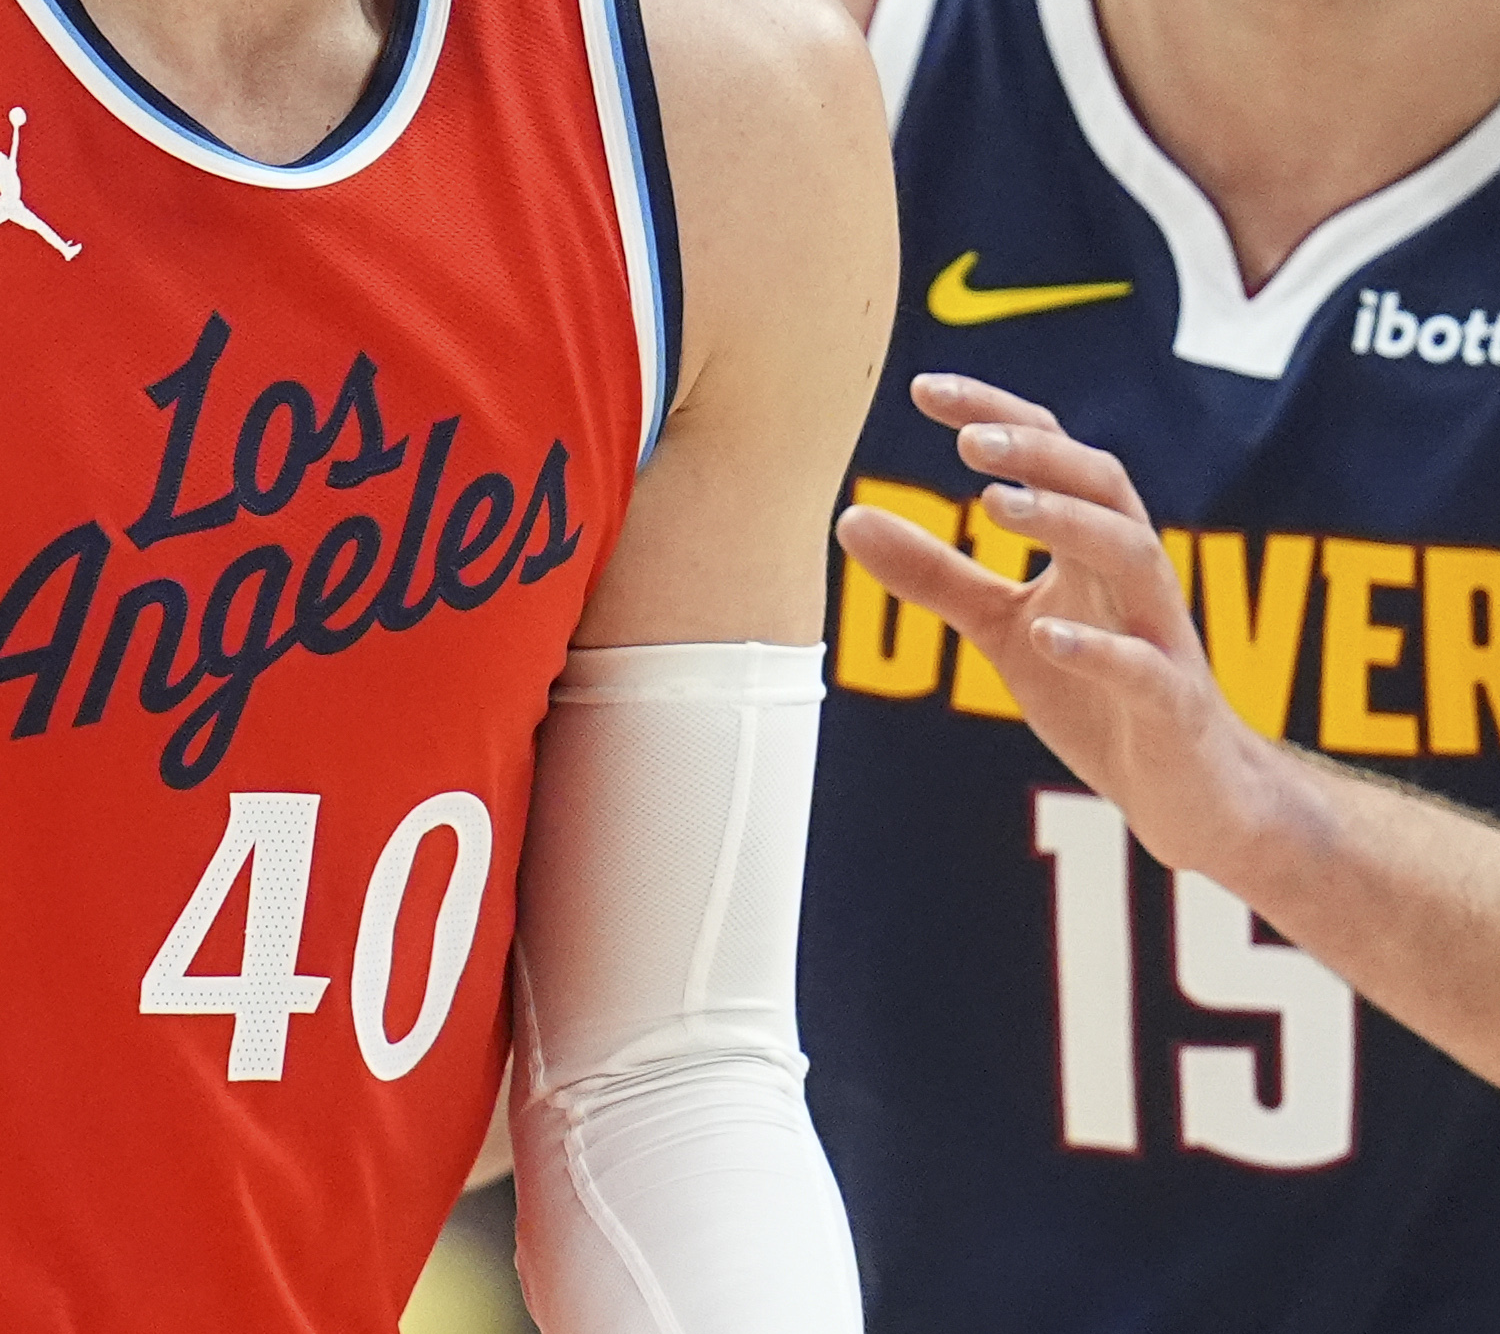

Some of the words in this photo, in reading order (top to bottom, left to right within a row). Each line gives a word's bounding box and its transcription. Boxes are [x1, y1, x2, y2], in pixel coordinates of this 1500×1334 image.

[129, 310, 416, 553] Los
[139, 789, 495, 1083] 40
[1031, 785, 1359, 1173] 15
